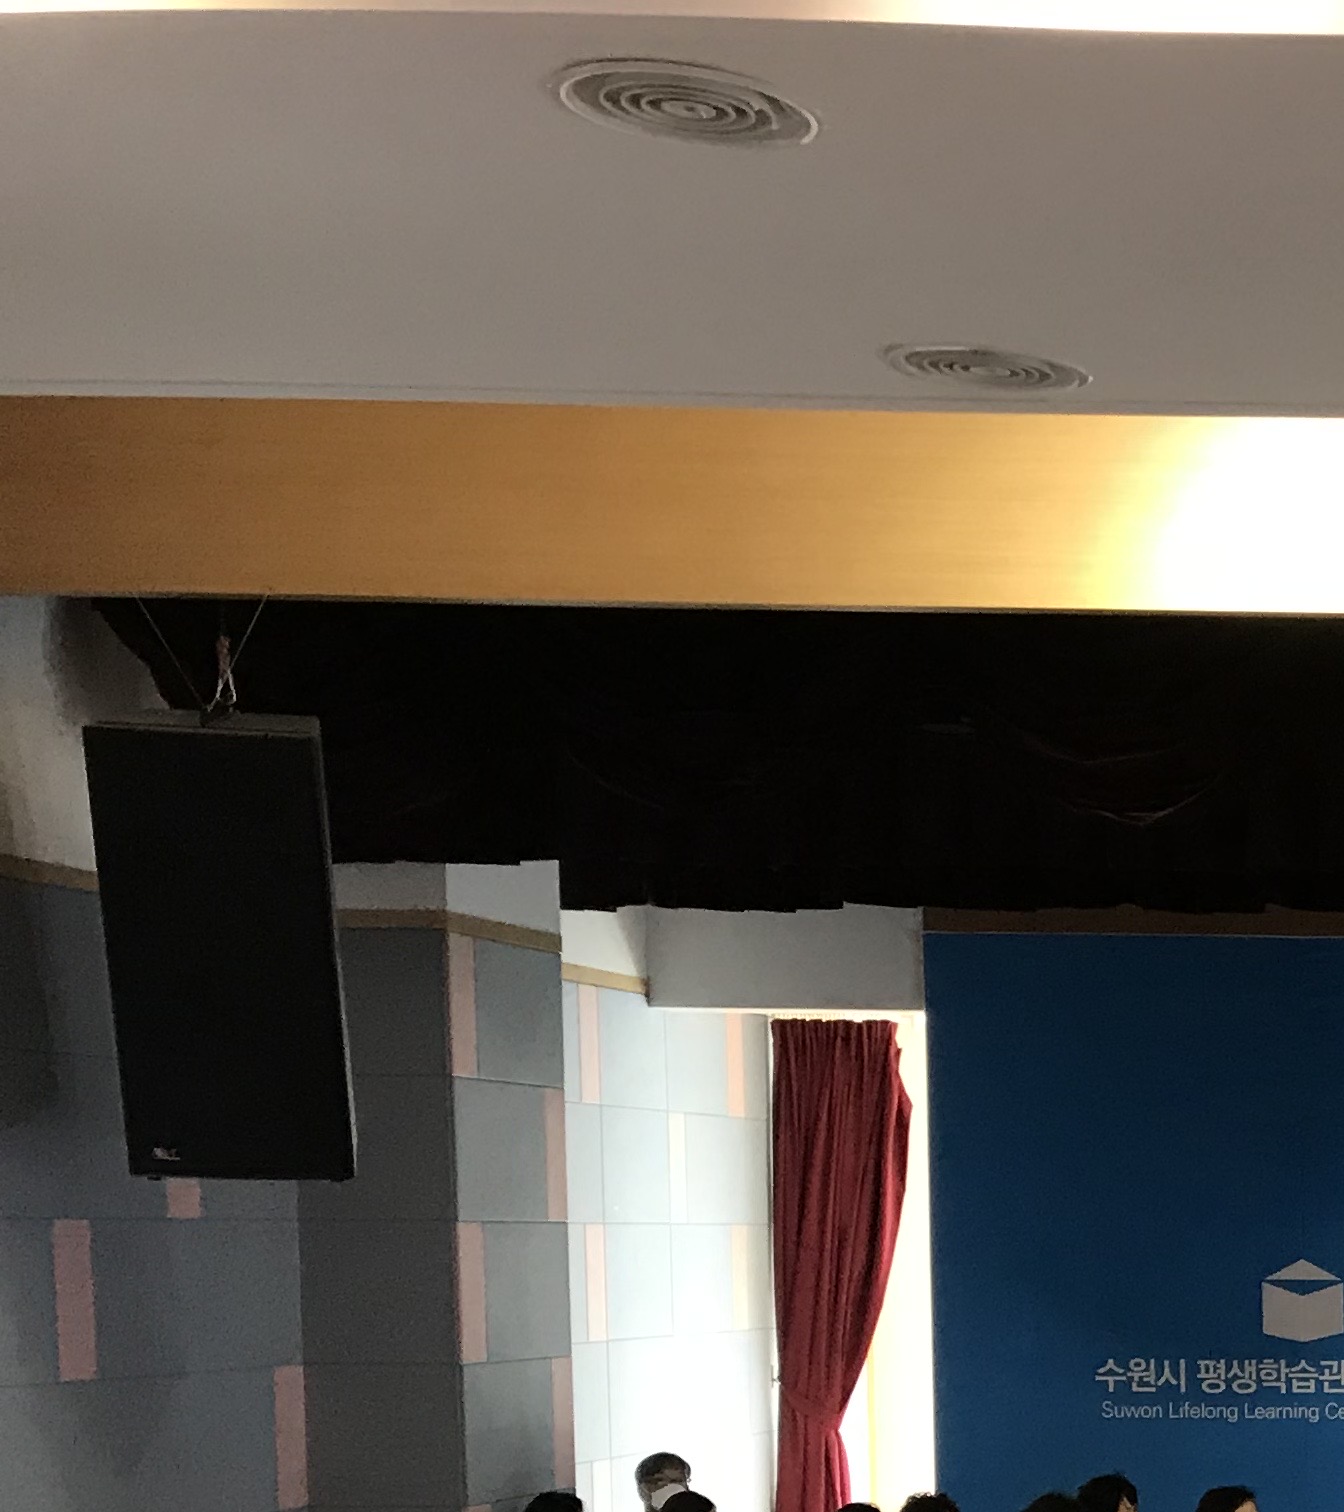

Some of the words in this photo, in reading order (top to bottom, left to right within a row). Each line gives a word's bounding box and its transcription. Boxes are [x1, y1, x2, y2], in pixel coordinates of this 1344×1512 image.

[1094, 1357, 1186, 1394] 수원시
[1101, 1401, 1163, 1419] Suwon
[1169, 1401, 1239, 1423] Lifelong
[1245, 1402, 1320, 1423] Learning
